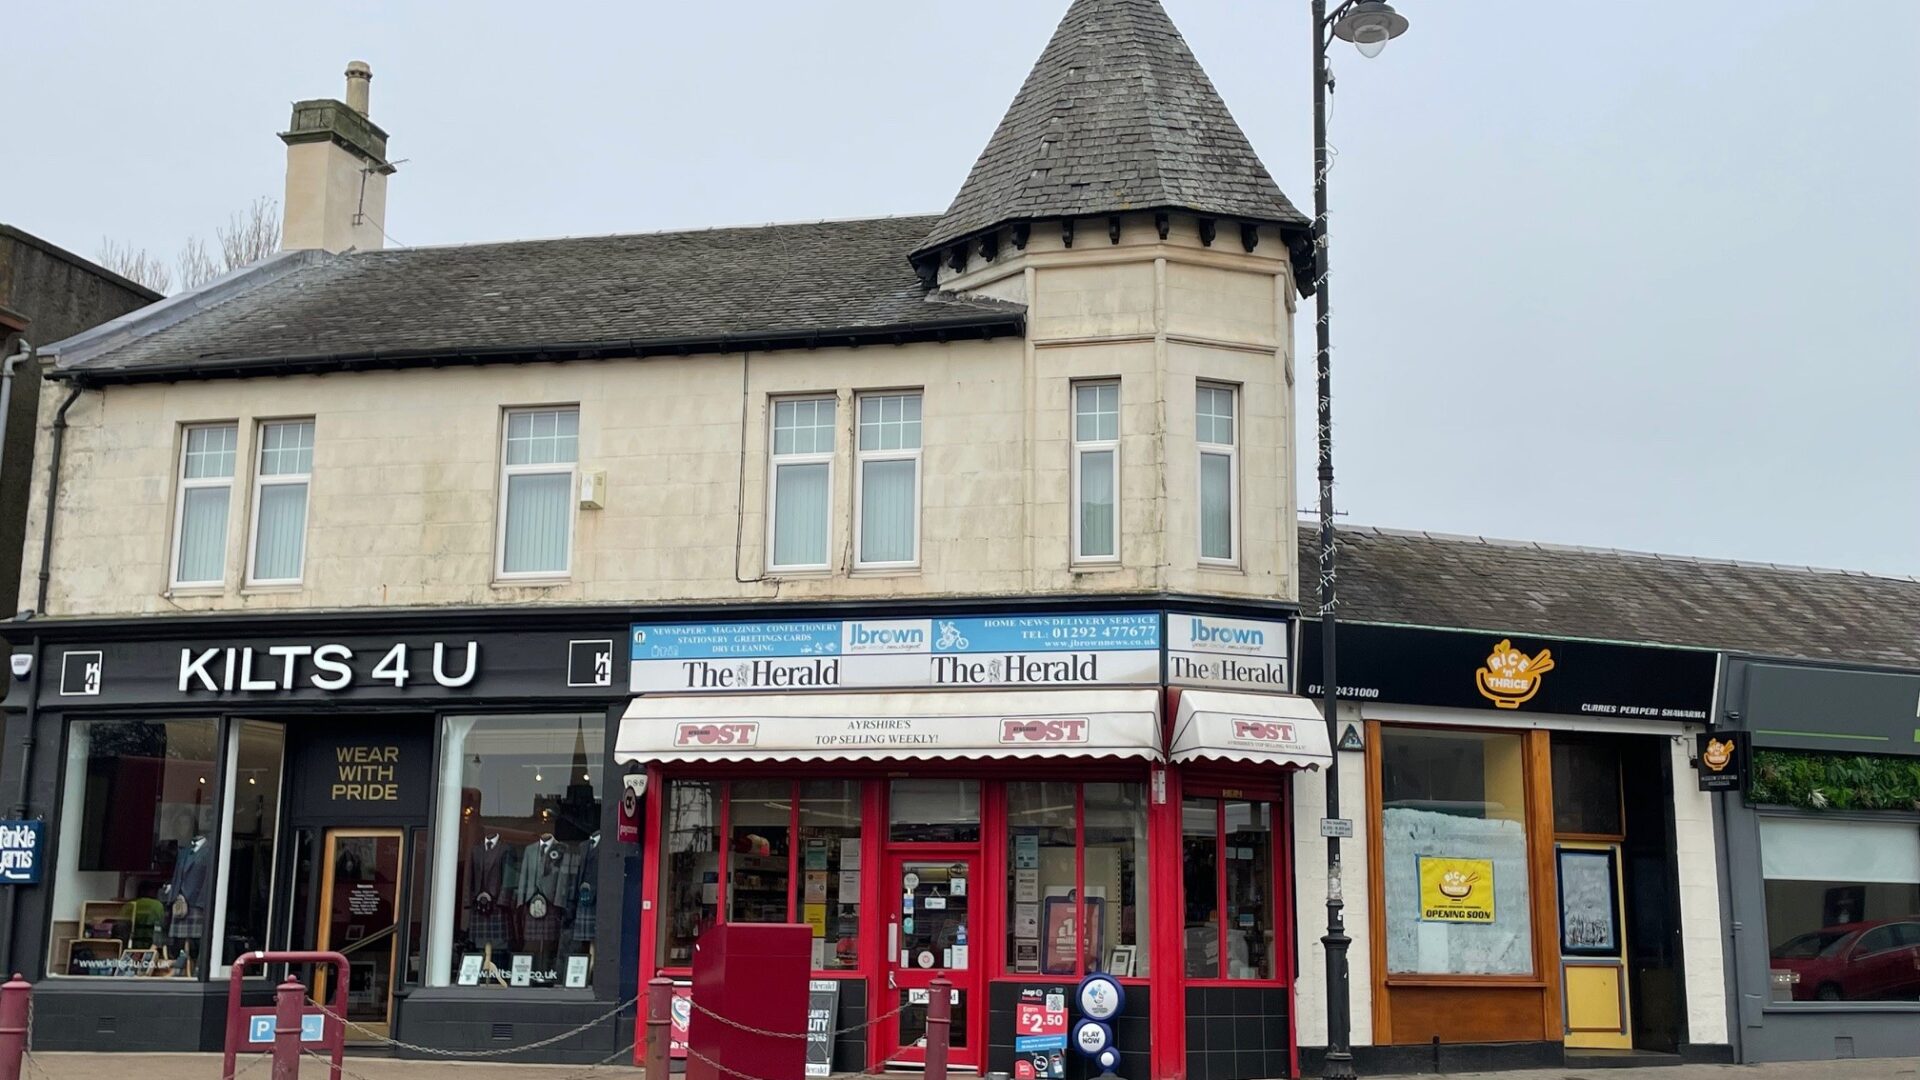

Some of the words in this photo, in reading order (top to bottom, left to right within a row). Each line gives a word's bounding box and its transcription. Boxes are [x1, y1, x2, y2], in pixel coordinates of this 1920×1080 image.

[653, 627, 706, 635] NEWSPAPERS
[766, 624, 837, 632] CONFECTIONERY
[1052, 618, 1105, 626] DELIVERY
[734, 634, 782, 643] GREETINGS
[850, 623, 924, 645] Jbrown
[1021, 631, 1048, 639] TEL:
[1053, 627, 1097, 638] 01292
[1102, 626, 1156, 637] 477677
[1190, 618, 1264, 645] Jbrown
[731, 644, 774, 652] CLEANING
[178, 644, 353, 691] KILTS
[372, 643, 409, 687] 4
[432, 641, 477, 687] U
[931, 656, 985, 683] The
[1004, 654, 1099, 682] Herald
[1491, 652, 1529, 672] RICE
[683, 661, 733, 687] The
[752, 659, 839, 686] Herald
[1171, 657, 1208, 679] The
[1222, 660, 1284, 684] Herald
[1308, 684, 1379, 698] 012431000
[1489, 678, 1529, 689] THRICE
[1581, 703, 1616, 713] CURRIES
[1661, 708, 1706, 718] SHAWARMA
[847, 720, 911, 730] AYRSHIRE'S
[1003, 720, 1085, 741] POST
[1234, 721, 1292, 740] POST
[677, 723, 756, 744] POST
[815, 736, 837, 745] TOP
[839, 735, 885, 744] SELLING
[888, 734, 939, 744] WEEKLY!
[336, 746, 399, 762] WEAR
[339, 766, 394, 781] WITH
[332, 784, 399, 800] PRIDE
[1426, 910, 1465, 918] OPENING
[1466, 911, 1490, 919] SOON
[256, 1020, 270, 1036] P
[1022, 1013, 1063, 1033] £2.50
[806, 1064, 828, 1074] erald
